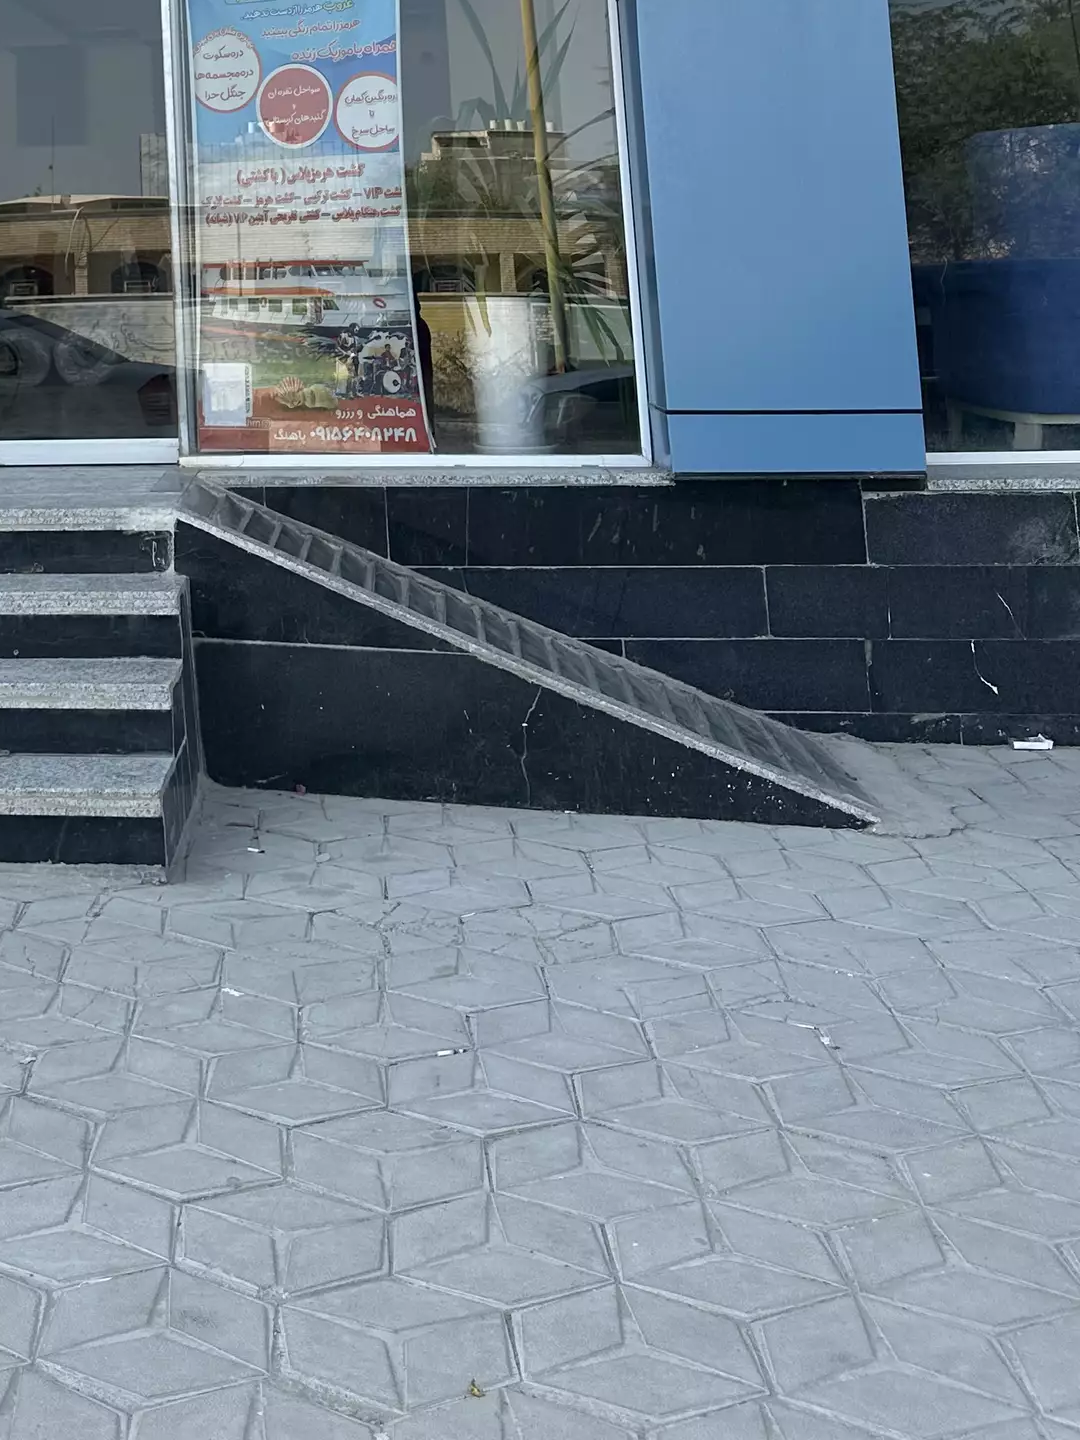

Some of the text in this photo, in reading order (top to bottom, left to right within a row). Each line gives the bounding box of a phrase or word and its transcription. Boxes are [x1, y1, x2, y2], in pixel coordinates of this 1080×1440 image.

[309, 20, 333, 34] تمام
[338, 18, 361, 32] هرمز
[203, 44, 244, 62] دره سکوت
[291, 46, 318, 63] زنده
[240, 68, 254, 79] دره
[204, 84, 247, 102] جنگل حرا
[293, 85, 321, 97] سواحل
[351, 123, 395, 142] ساحل سرخ
[363, 187, 383, 199] VIP
[335, 404, 417, 420] هماهنگی و رزرو
[309, 425, 418, 443] ۰۹۱۵۶۴۰۸۲۴۸
